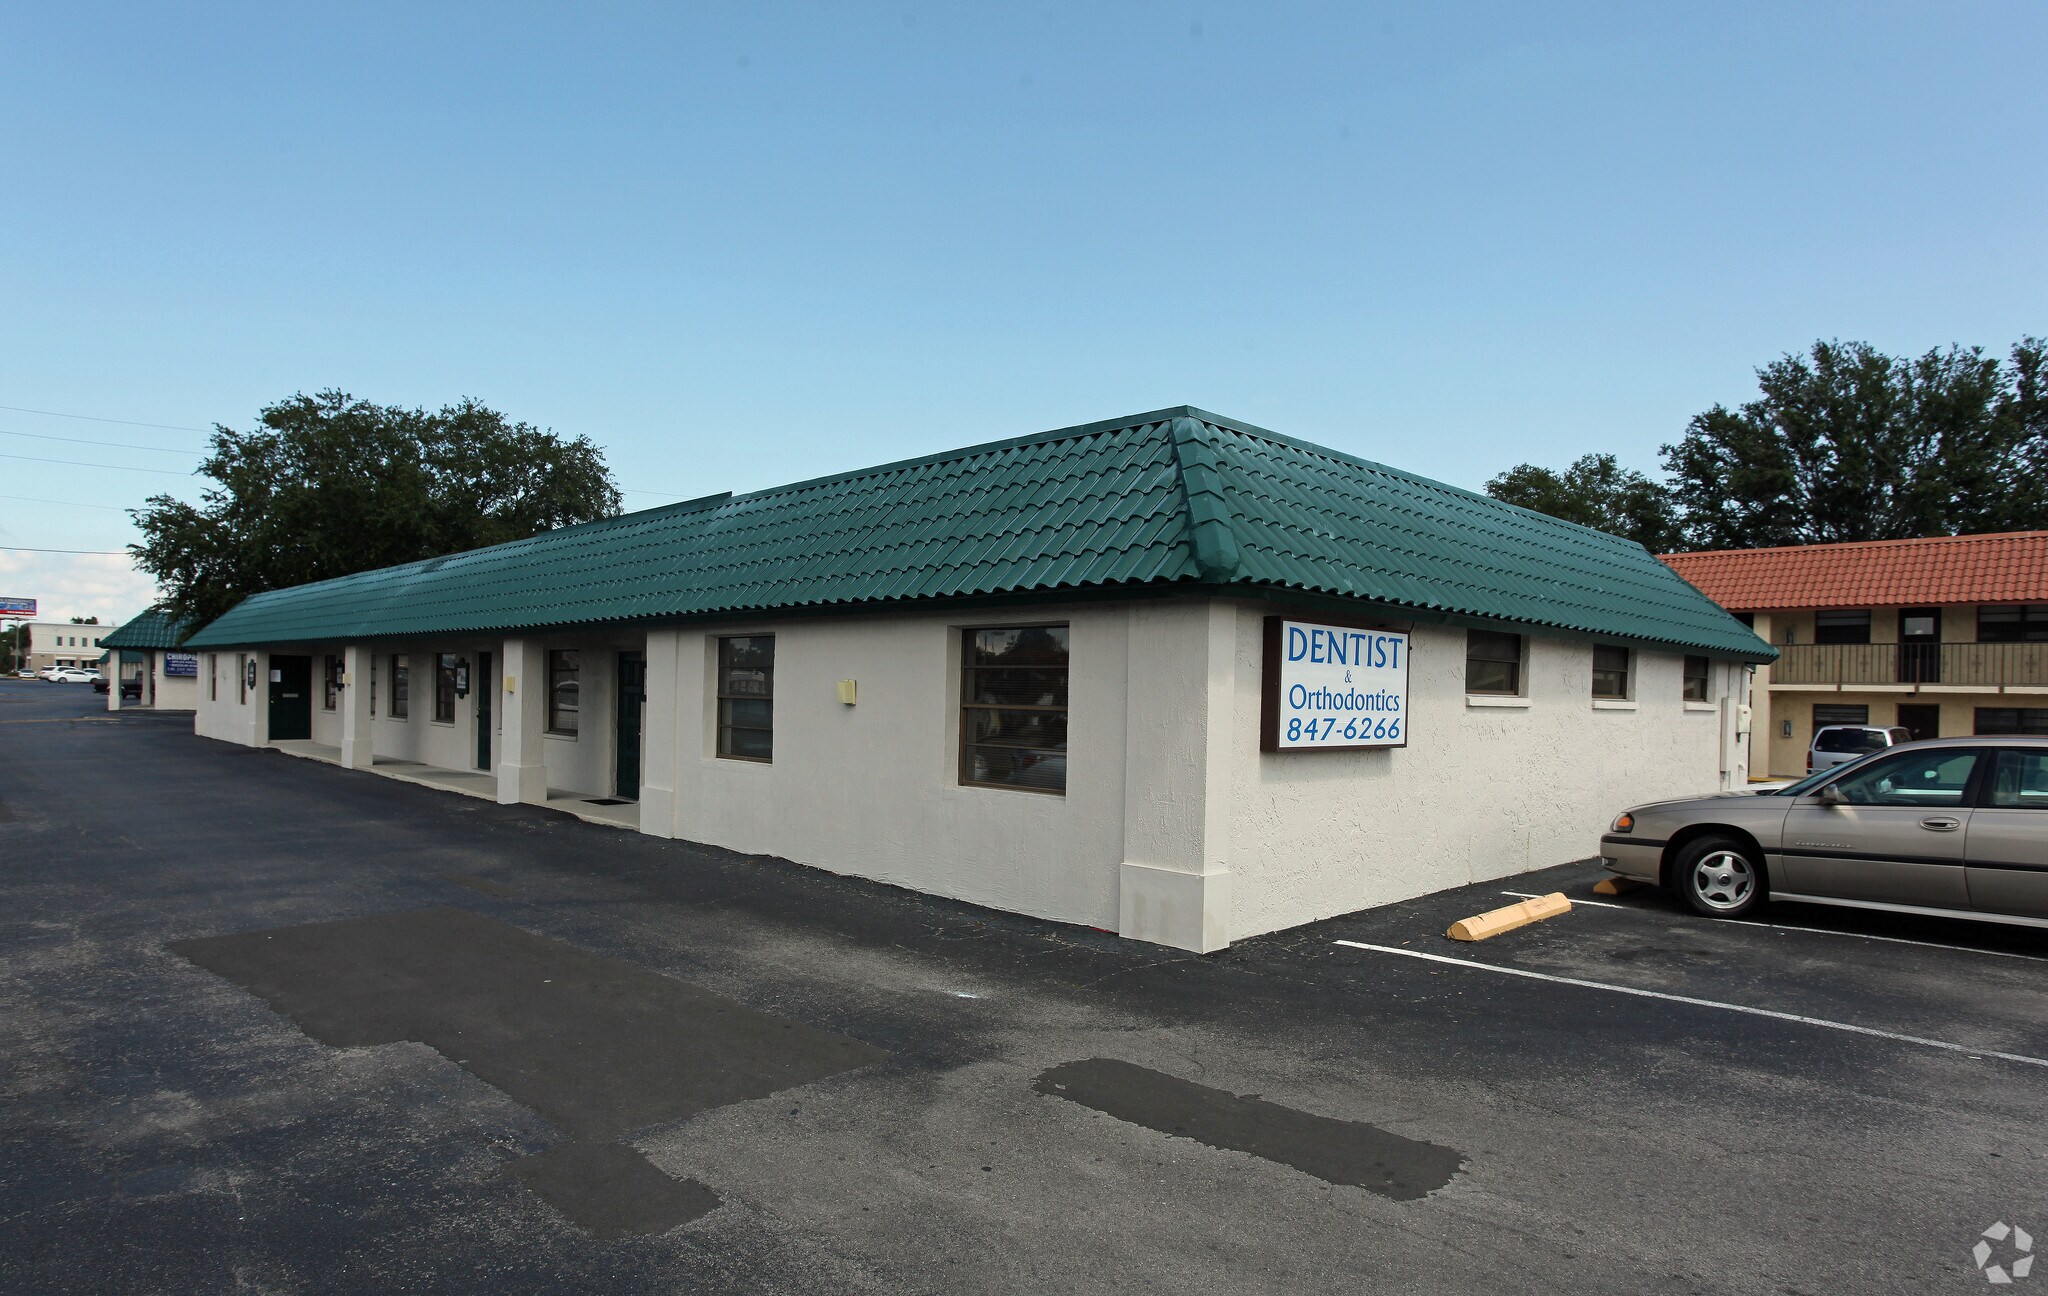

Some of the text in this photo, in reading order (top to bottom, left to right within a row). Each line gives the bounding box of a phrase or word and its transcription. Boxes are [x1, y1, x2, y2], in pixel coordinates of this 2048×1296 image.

[1288, 627, 1403, 668] DENTIST
[1344, 670, 1352, 683] &
[1289, 684, 1399, 711] Orthodontics
[1287, 717, 1400, 741] 847-6266
